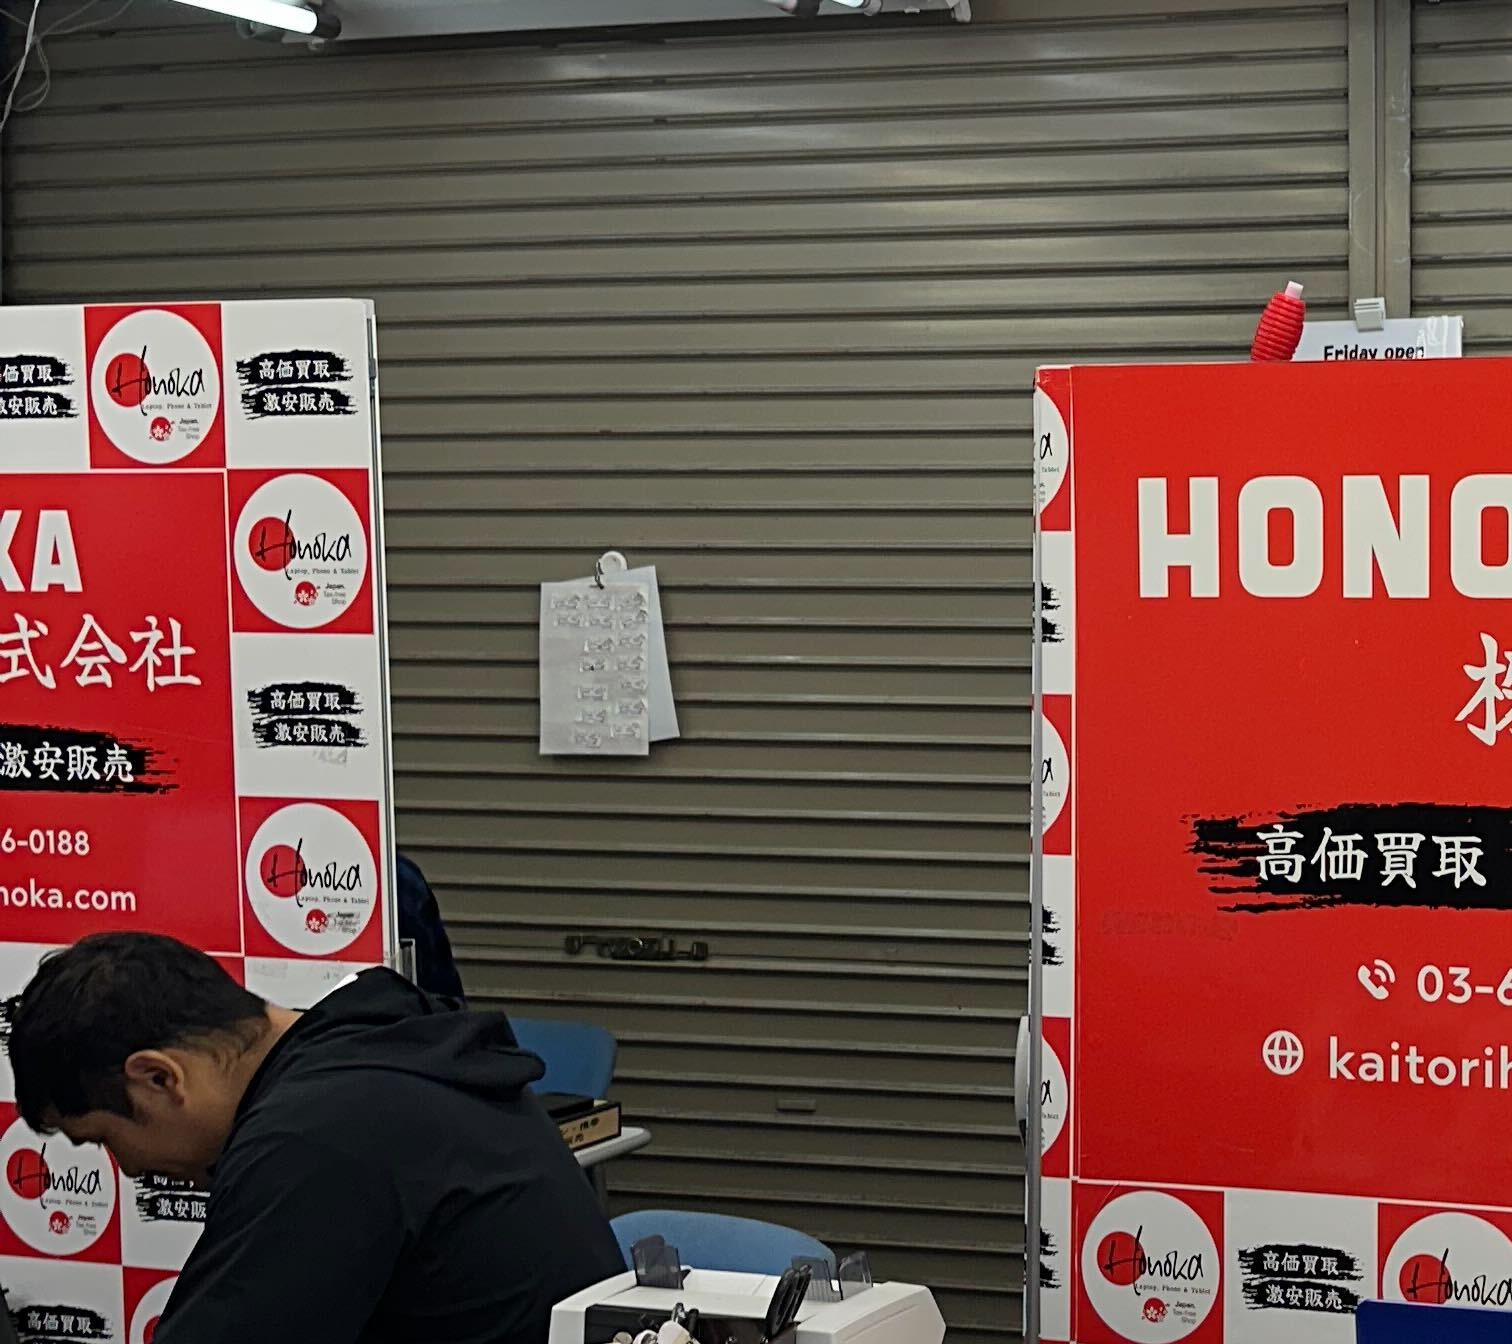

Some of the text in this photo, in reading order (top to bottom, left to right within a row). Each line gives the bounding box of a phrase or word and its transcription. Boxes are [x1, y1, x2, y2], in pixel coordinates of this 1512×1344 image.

[0, 365, 53, 383] 価買取
[113, 346, 205, 416] Honoka
[259, 359, 330, 379] 高価買取
[264, 392, 335, 412] 激安販売
[255, 509, 352, 580] Honoka
[0, 612, 201, 693] 式会社
[270, 689, 341, 711] 高価買取
[274, 722, 345, 743] 激安販売
[2, 828, 90, 856] 6-0188
[1255, 824, 1488, 889] 高価買取
[267, 838, 362, 907] Honoka
[13, 1143, 102, 1209] Honoka
[1104, 1225, 1204, 1296] Honoka
[1263, 1251, 1338, 1275] 高価買取
[1266, 1284, 1343, 1309] 激安販売
[28, 1310, 92, 1334] 高価買取
